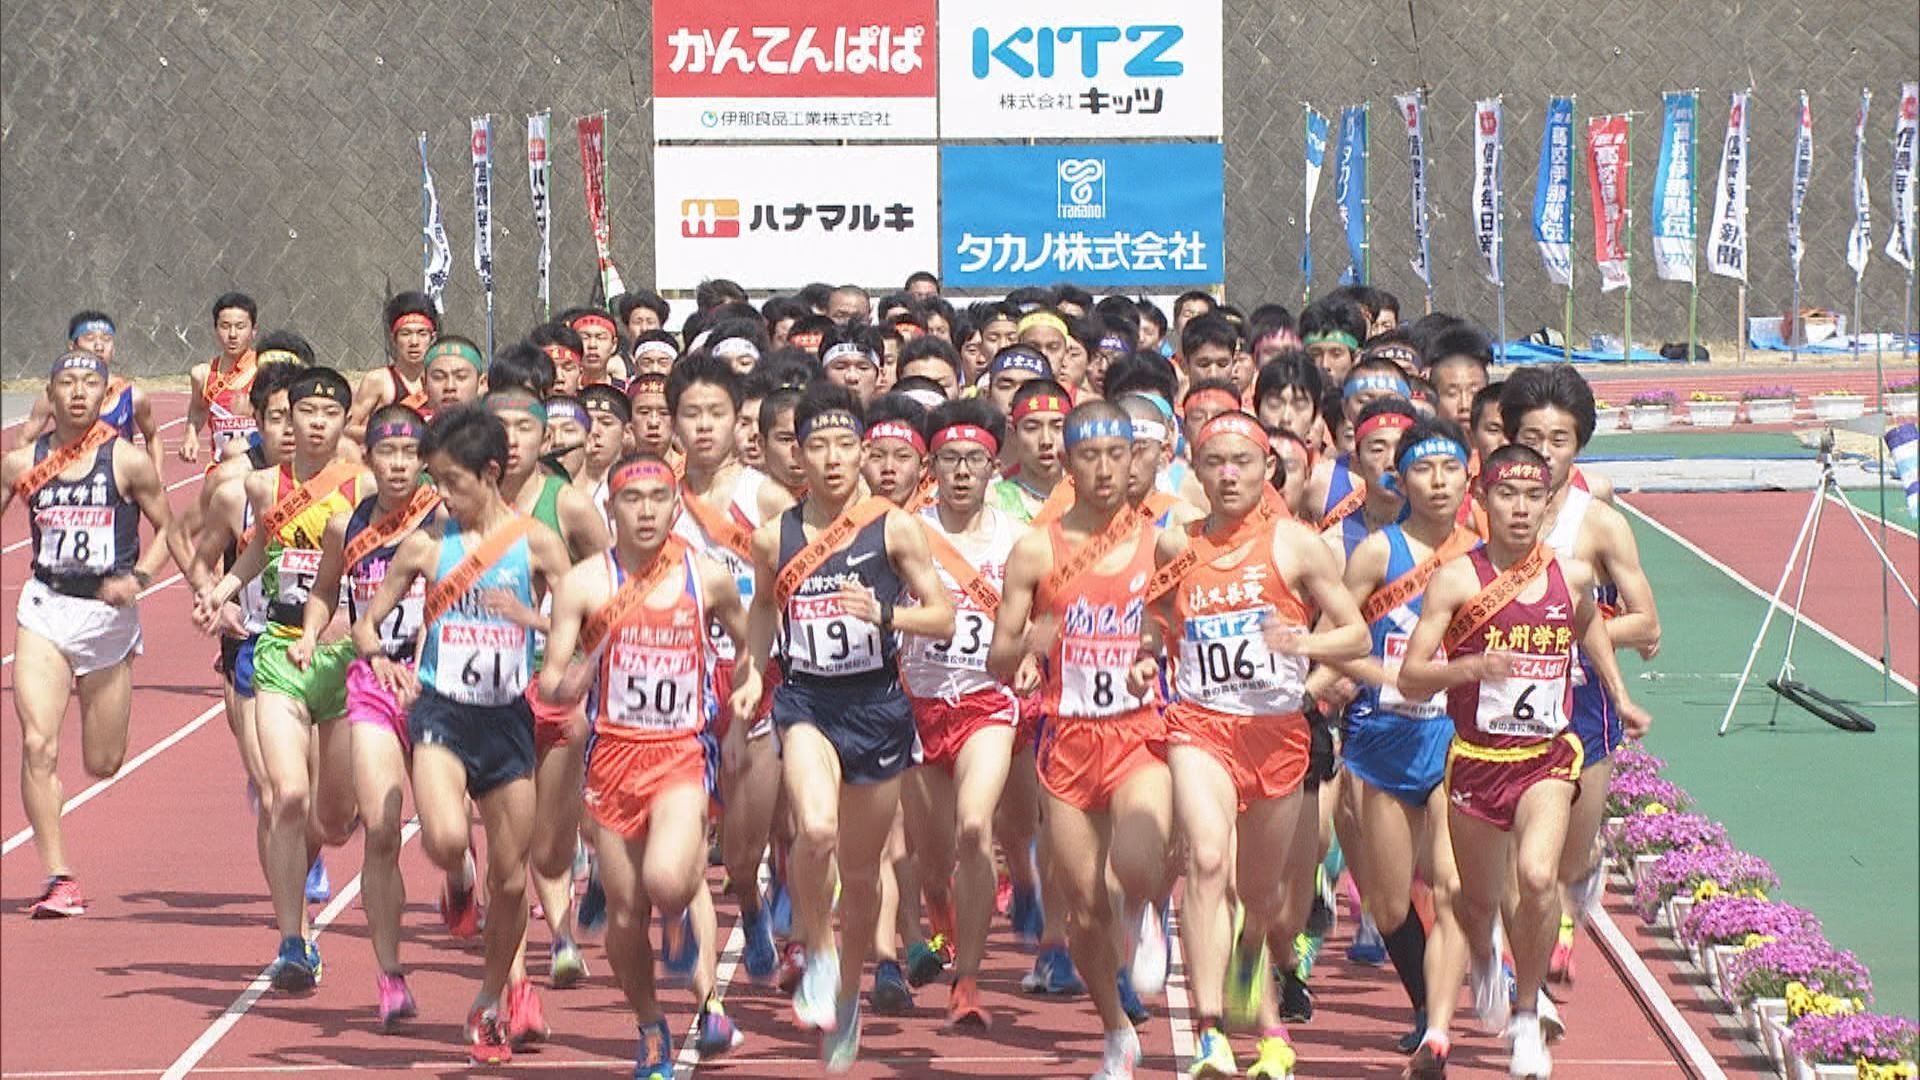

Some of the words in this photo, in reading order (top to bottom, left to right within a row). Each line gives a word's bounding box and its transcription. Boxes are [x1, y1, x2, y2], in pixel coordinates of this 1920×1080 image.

[667, 26, 925, 75] かんてんぱぱ
[971, 25, 1184, 78] KITZ
[720, 110, 893, 127] 伊那食品工業株式会社
[748, 203, 915, 232] ハナマルキ
[956, 230, 1207, 272] タカノ株式会社
[807, 621, 875, 663] 19-1
[1191, 611, 1264, 638] KITZ
[1484, 624, 1572, 654] 九州学院
[1196, 639, 1276, 686] 106-1
